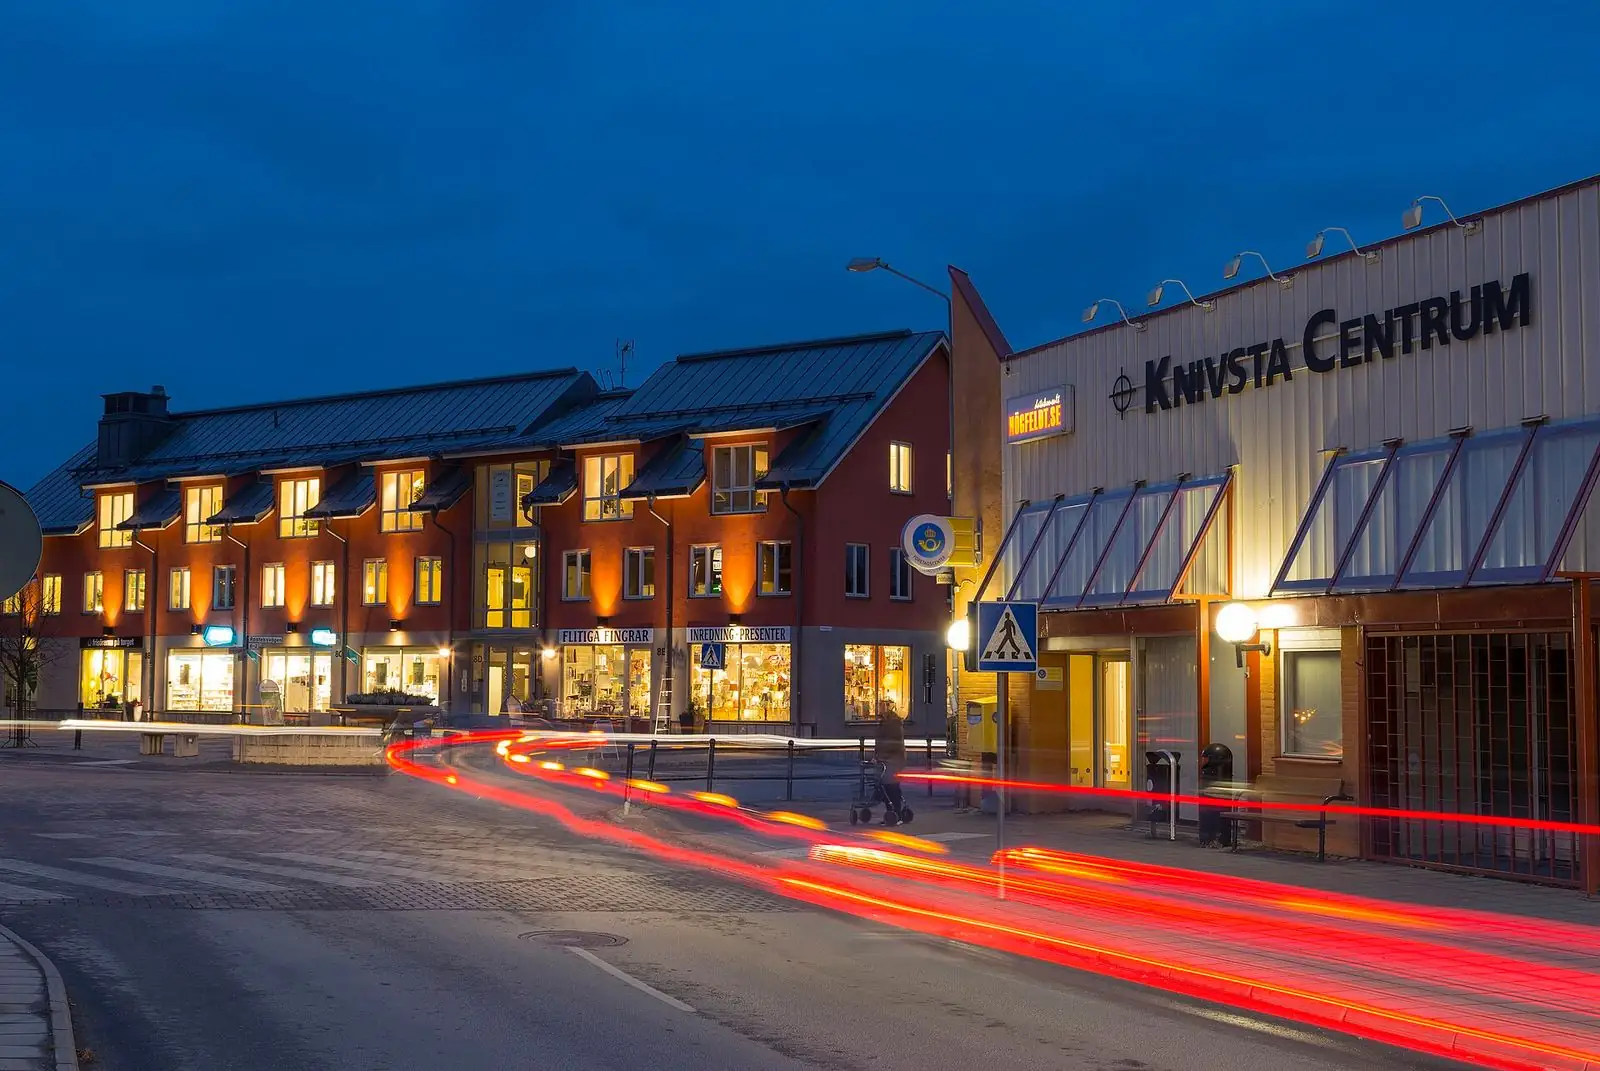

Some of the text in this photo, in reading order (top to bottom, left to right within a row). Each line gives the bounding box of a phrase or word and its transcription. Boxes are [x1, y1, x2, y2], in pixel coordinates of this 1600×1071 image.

[1144, 272, 1531, 414] KNIVSTA CENTRUM
[562, 629, 649, 643] FLITIGA FINGRAR
[690, 627, 786, 641] INREDNING PRESENTER
